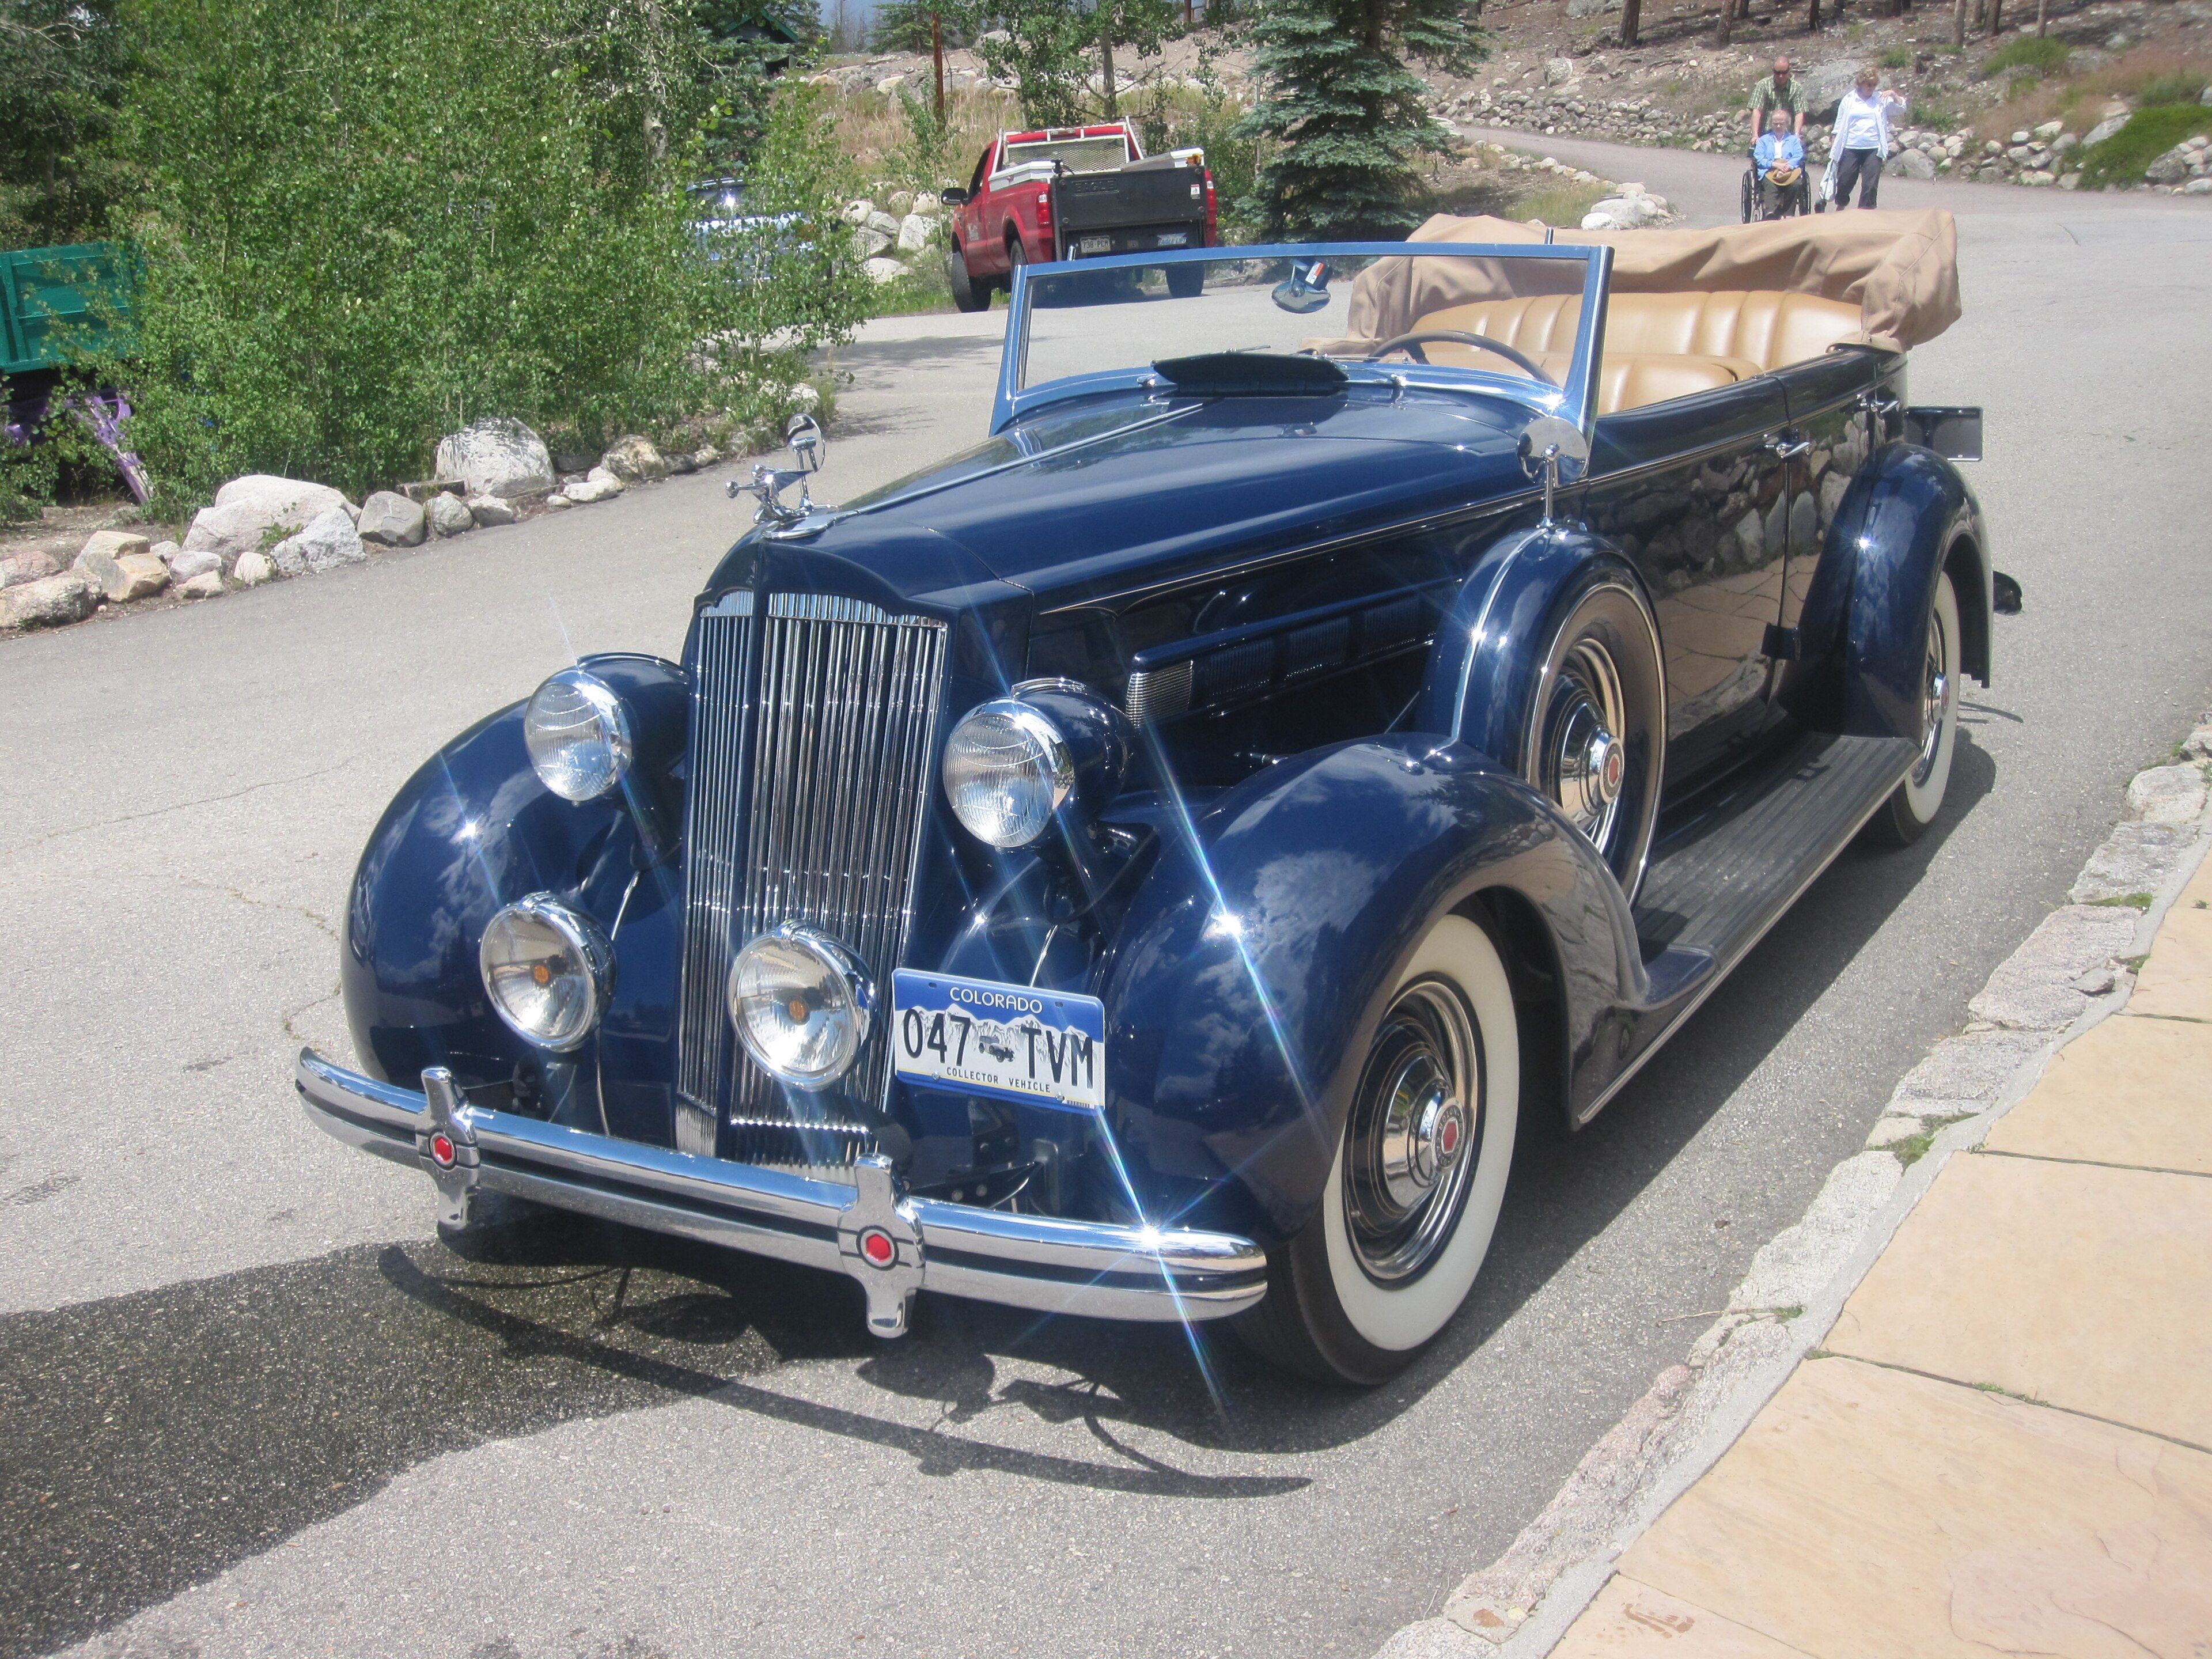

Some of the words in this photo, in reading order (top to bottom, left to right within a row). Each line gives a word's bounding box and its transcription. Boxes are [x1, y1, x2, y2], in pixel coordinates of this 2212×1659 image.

[949, 987, 1043, 1014] COLORADO
[903, 1008, 971, 1067] 047
[1020, 1025, 1093, 1089] TVM
[946, 1067, 999, 1085] COLLECTOR
[1009, 1077, 1051, 1093] VEHICLE
